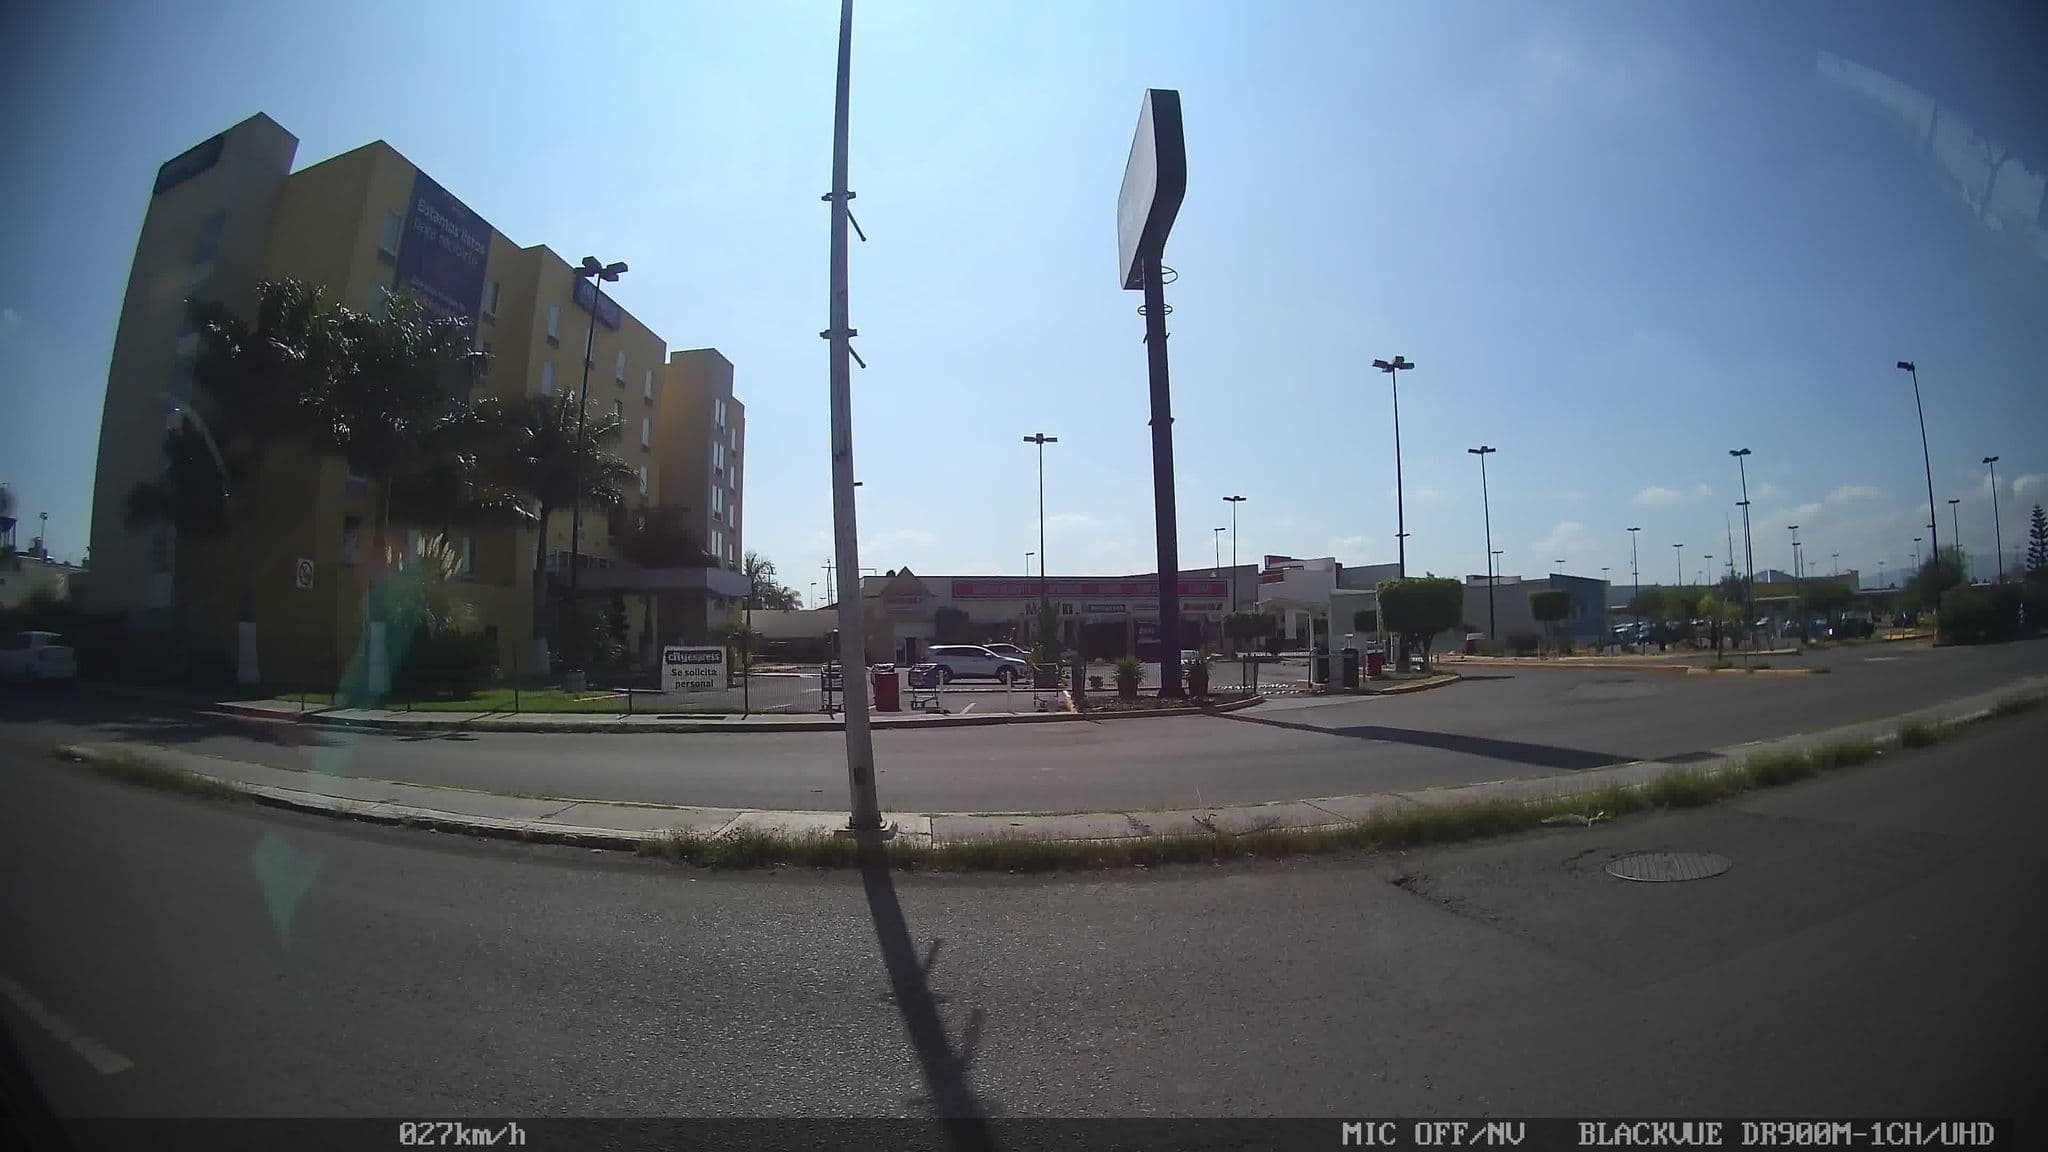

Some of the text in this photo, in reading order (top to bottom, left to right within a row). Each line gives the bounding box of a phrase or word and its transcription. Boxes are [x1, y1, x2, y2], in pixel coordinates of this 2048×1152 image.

[417, 198, 459, 238] Estamos
[462, 230, 486, 255] listos
[671, 668, 718, 677] Se solicita
[675, 679, 714, 690] personal
